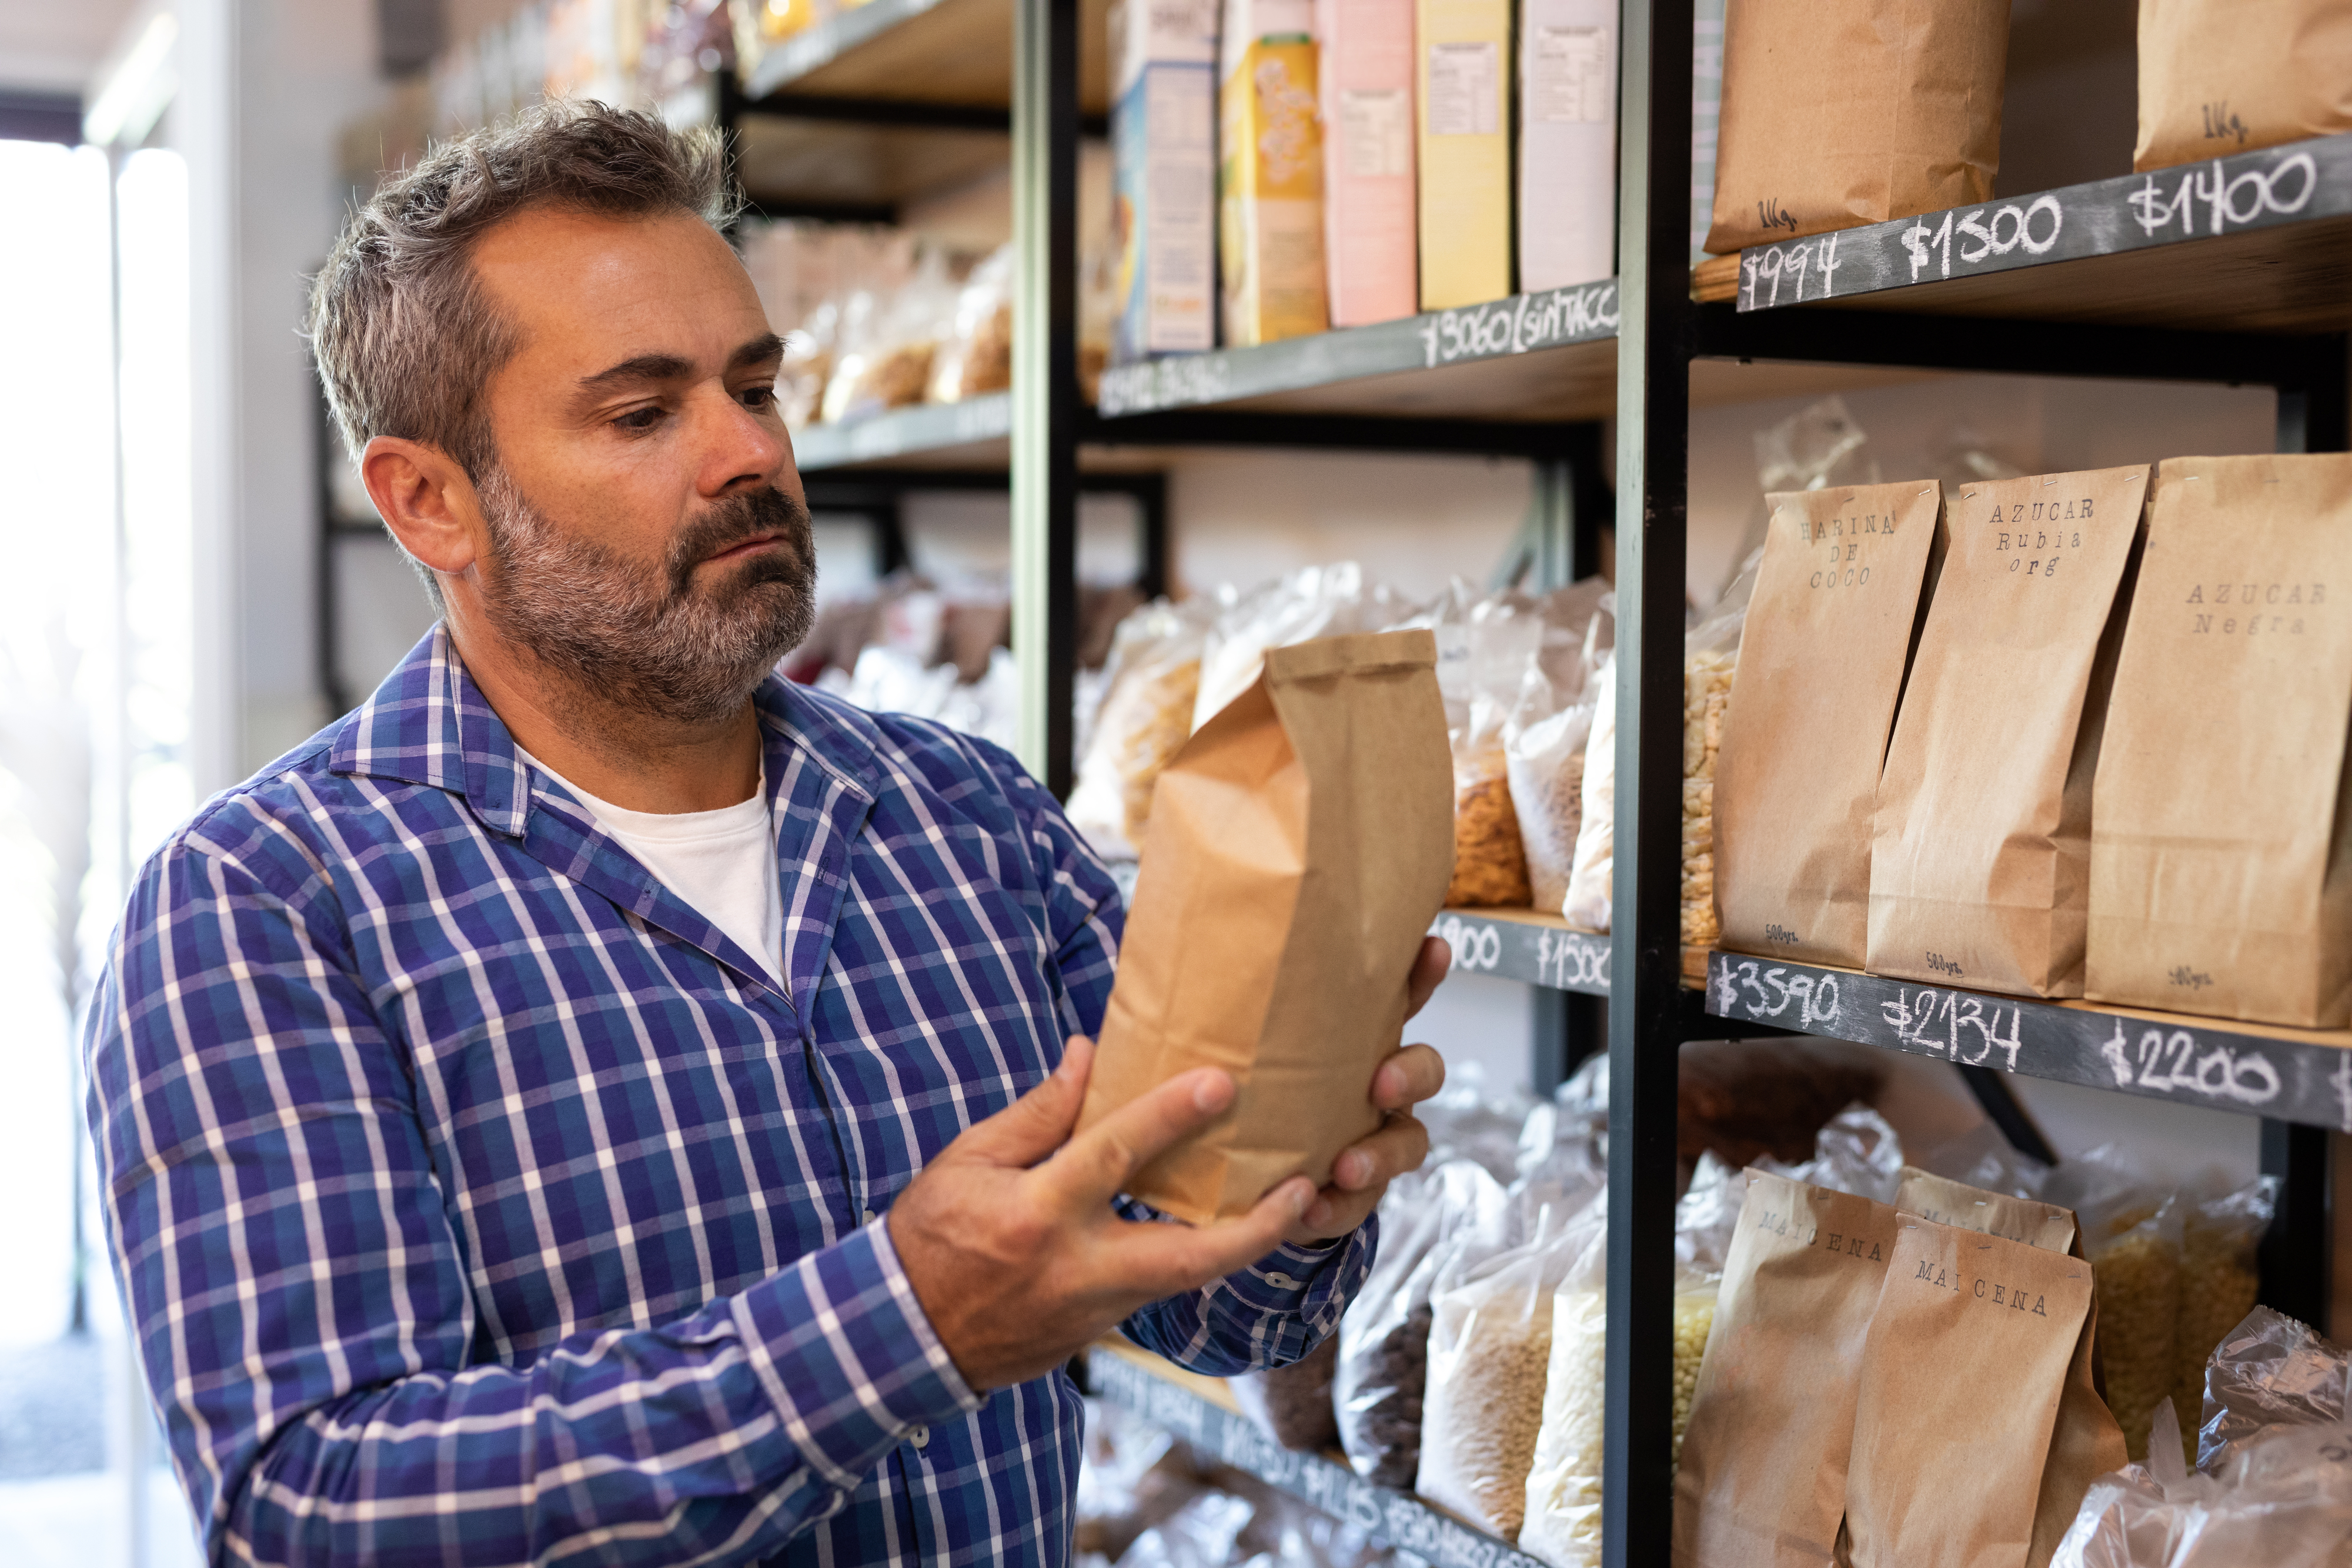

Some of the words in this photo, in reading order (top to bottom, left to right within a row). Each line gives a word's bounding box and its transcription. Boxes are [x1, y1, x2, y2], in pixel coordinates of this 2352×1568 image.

[2127, 152, 2317, 236] $1400
[1756, 197, 1798, 233] 1Kg.
[1901, 196, 2064, 284] $1500
[1742, 232, 1842, 310] $994
[1989, 499, 2094, 524] AZUCAR
[1830, 543, 1859, 563] DE
[1996, 530, 2083, 551] Rubia
[1810, 567, 1871, 590] COCO
[2009, 556, 2061, 578] org
[2185, 583, 2327, 604] AZUCAR
[2192, 613, 2305, 635] Negra
[1716, 955, 1840, 1030] $3590
[1880, 988, 2023, 1073] $2134
[2102, 1017, 2281, 1106] $2200
[1915, 1260, 2049, 1318] MAICENA
